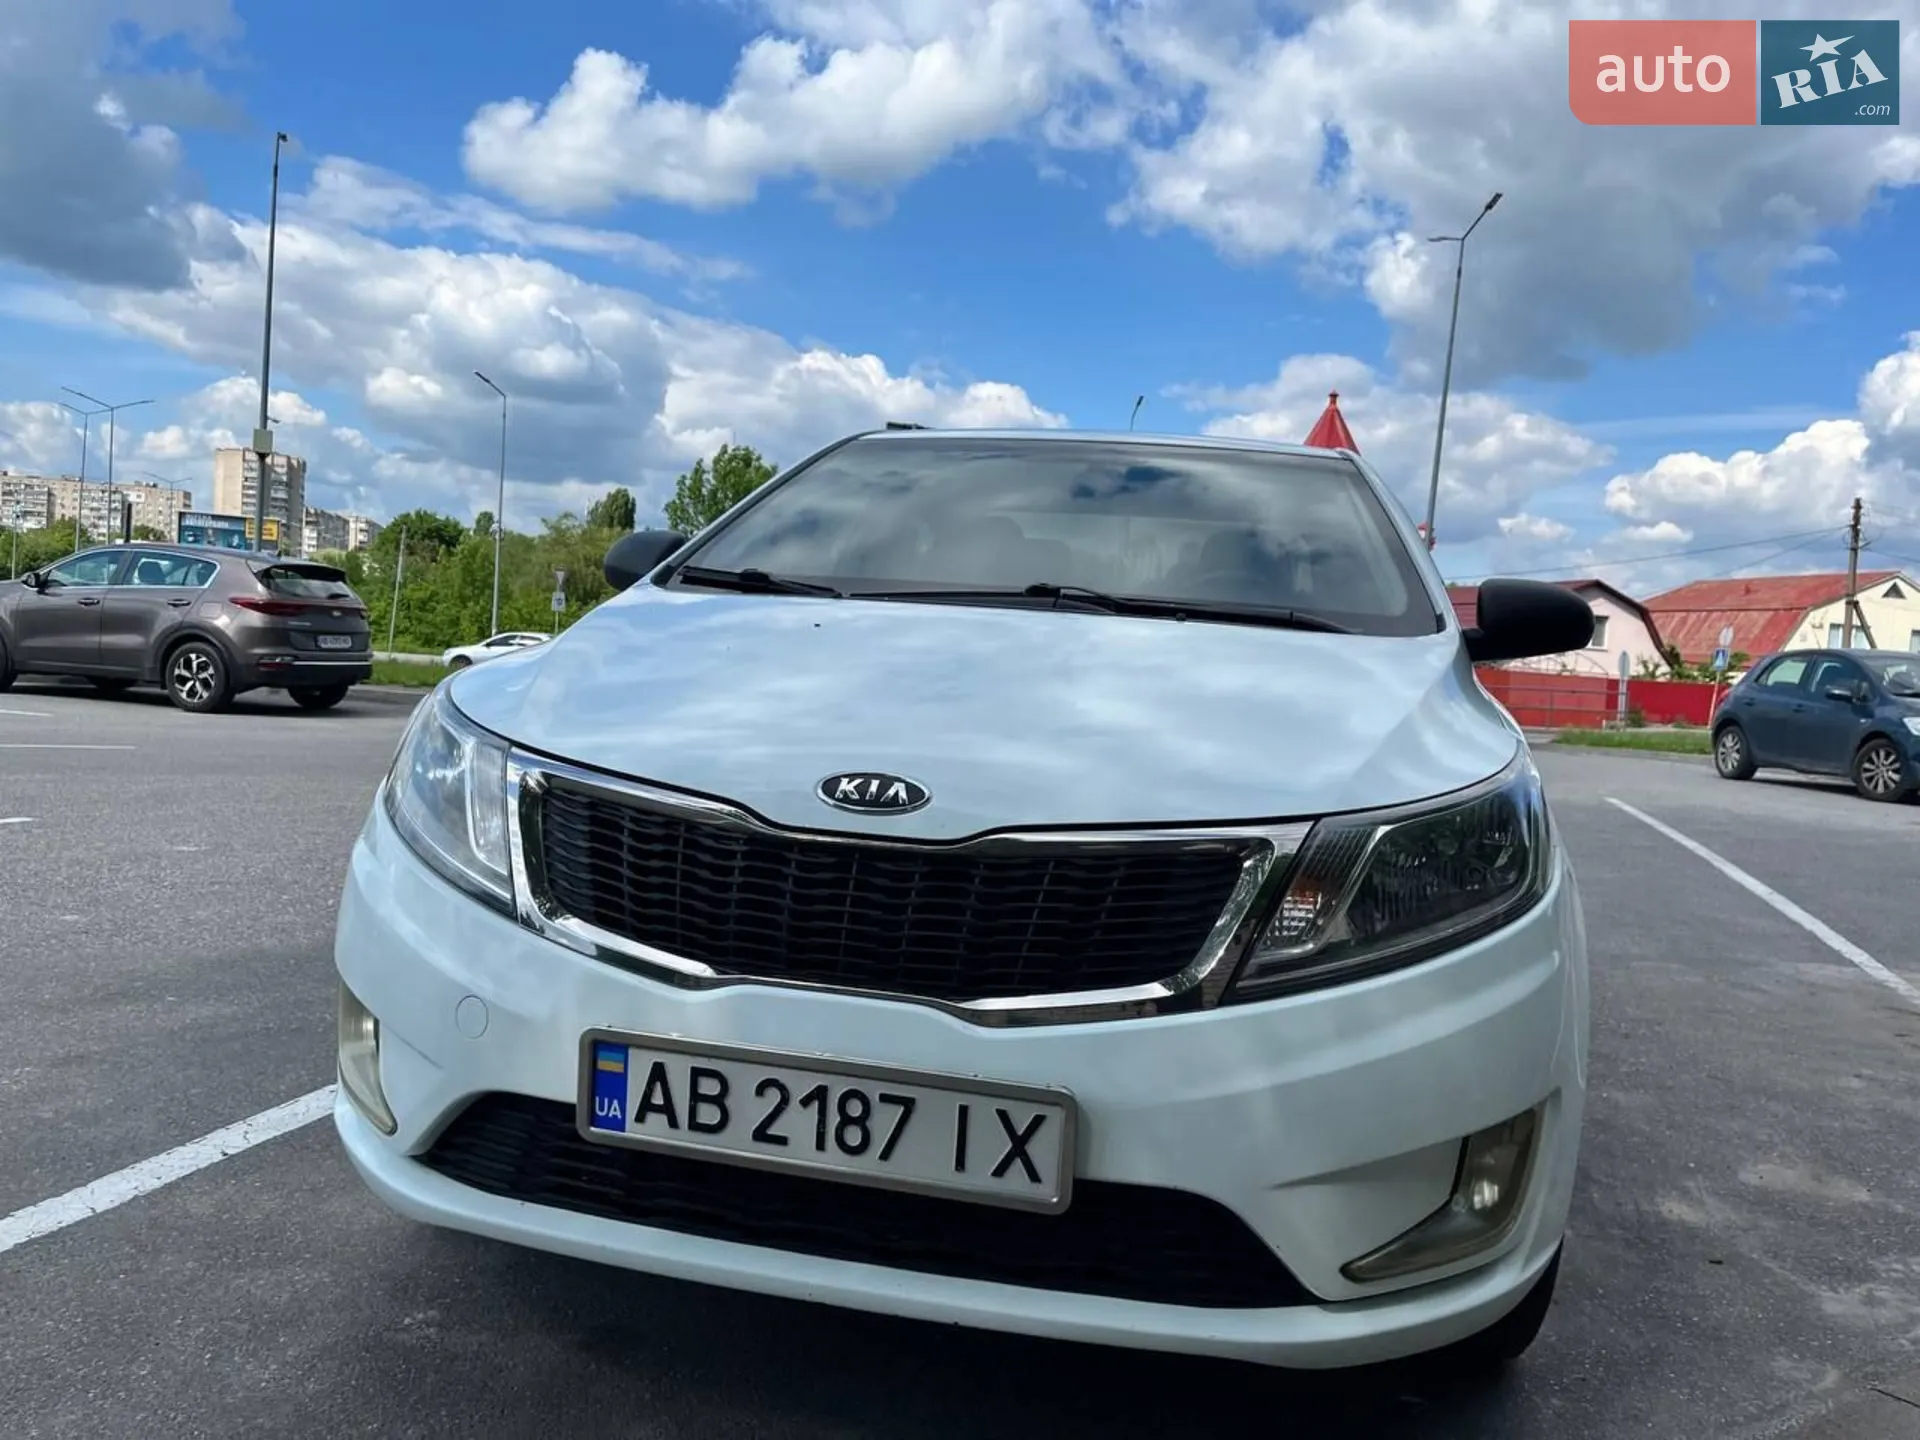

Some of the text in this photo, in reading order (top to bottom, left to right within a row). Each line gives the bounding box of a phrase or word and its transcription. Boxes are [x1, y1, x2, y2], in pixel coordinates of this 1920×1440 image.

[834, 777, 909, 805] KIA
[595, 1095, 622, 1119] UA
[634, 1061, 1047, 1184] AB 2187 IX
